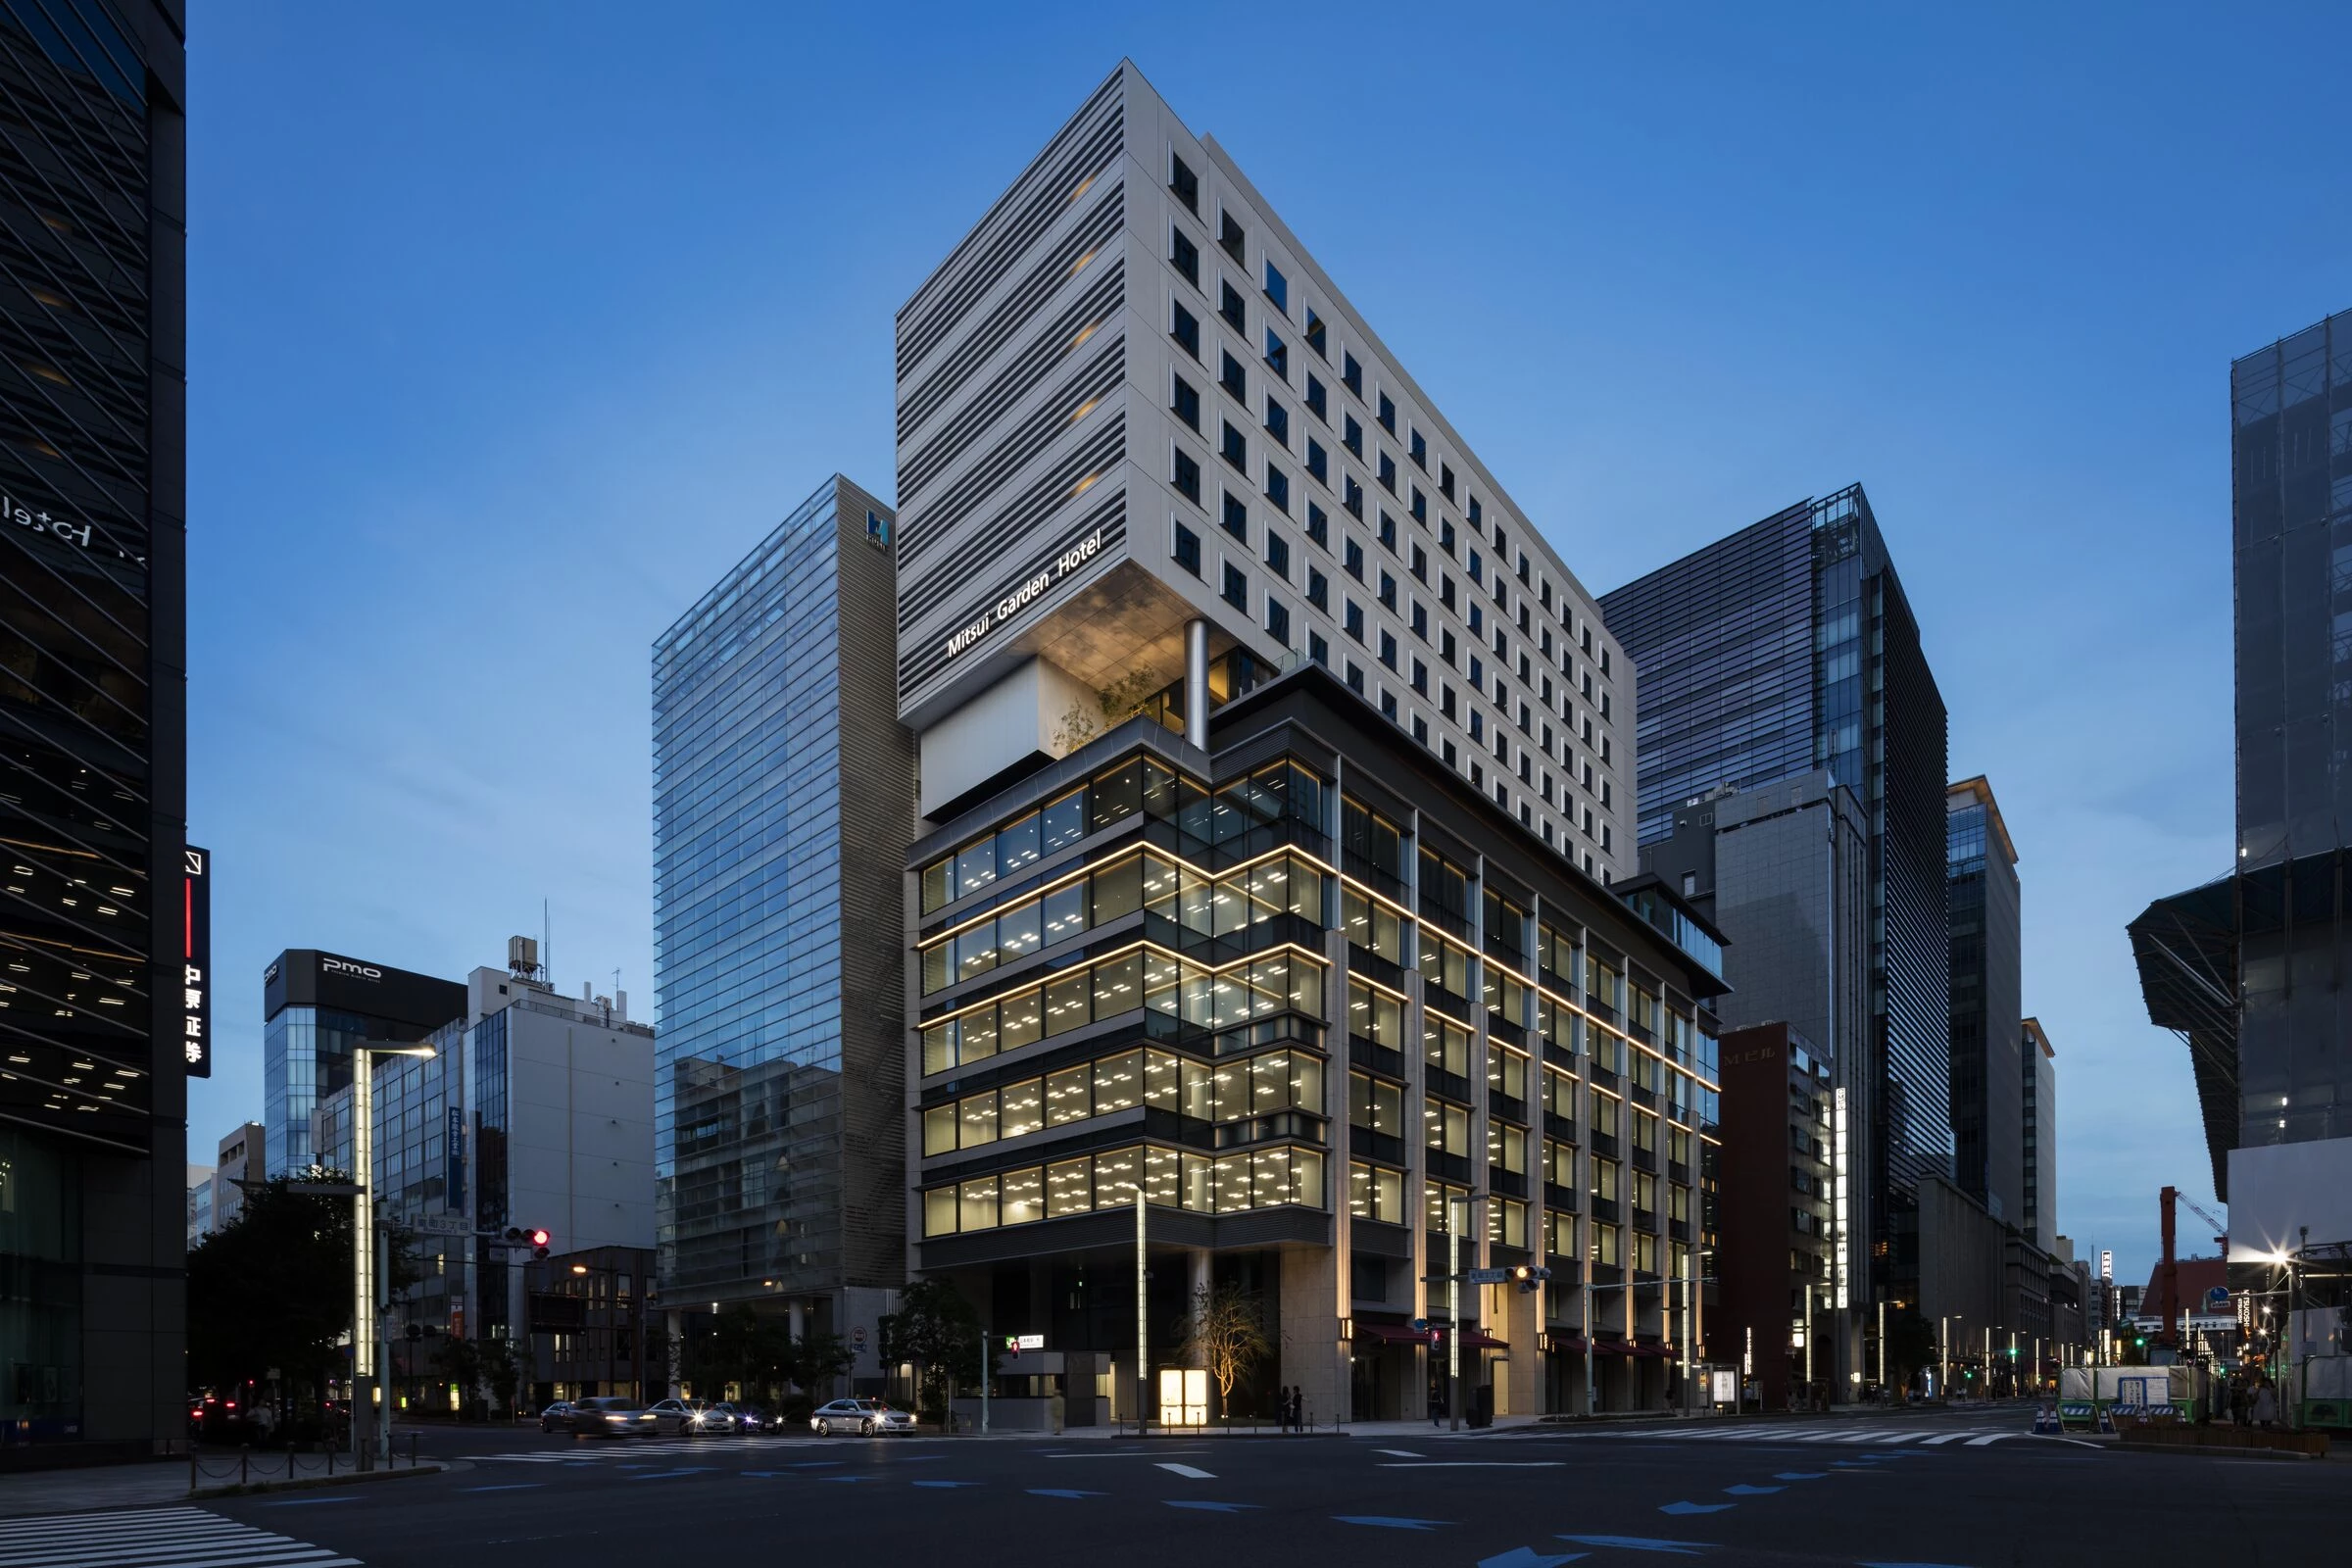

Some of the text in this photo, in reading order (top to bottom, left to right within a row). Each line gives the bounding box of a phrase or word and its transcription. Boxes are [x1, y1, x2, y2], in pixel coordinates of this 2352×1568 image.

[947, 528, 1102, 659] Mitsui Garden Hotel
